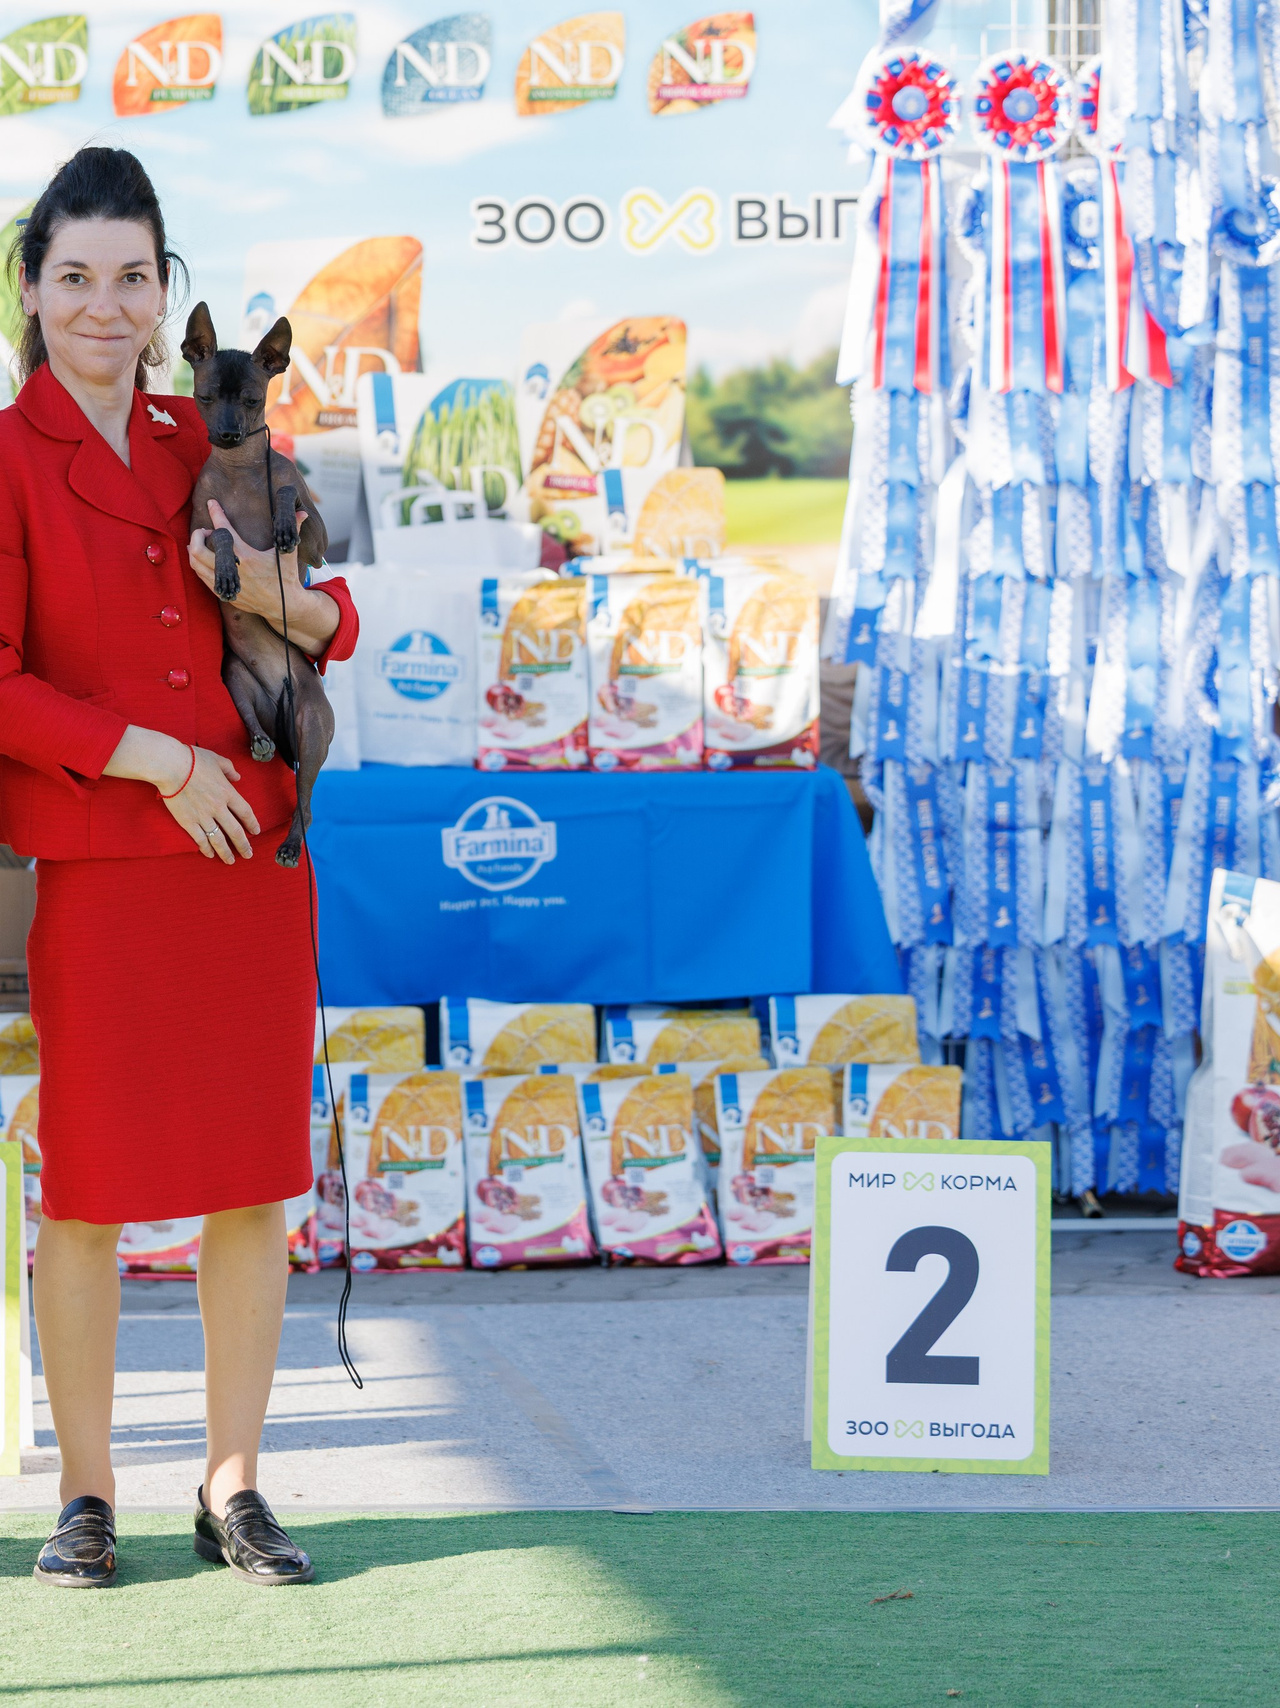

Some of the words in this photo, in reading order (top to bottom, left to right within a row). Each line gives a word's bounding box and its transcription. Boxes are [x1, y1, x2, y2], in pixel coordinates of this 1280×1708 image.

[477, 202, 605, 244] ЗОО
[454, 833, 544, 858] Farmina
[849, 1173, 896, 1188] МИР
[941, 1175, 1017, 1191] КОРМА
[885, 1225, 980, 1385] 2
[846, 1420, 889, 1436] ЗОО
[930, 1422, 1015, 1439] ВЫГОДА
